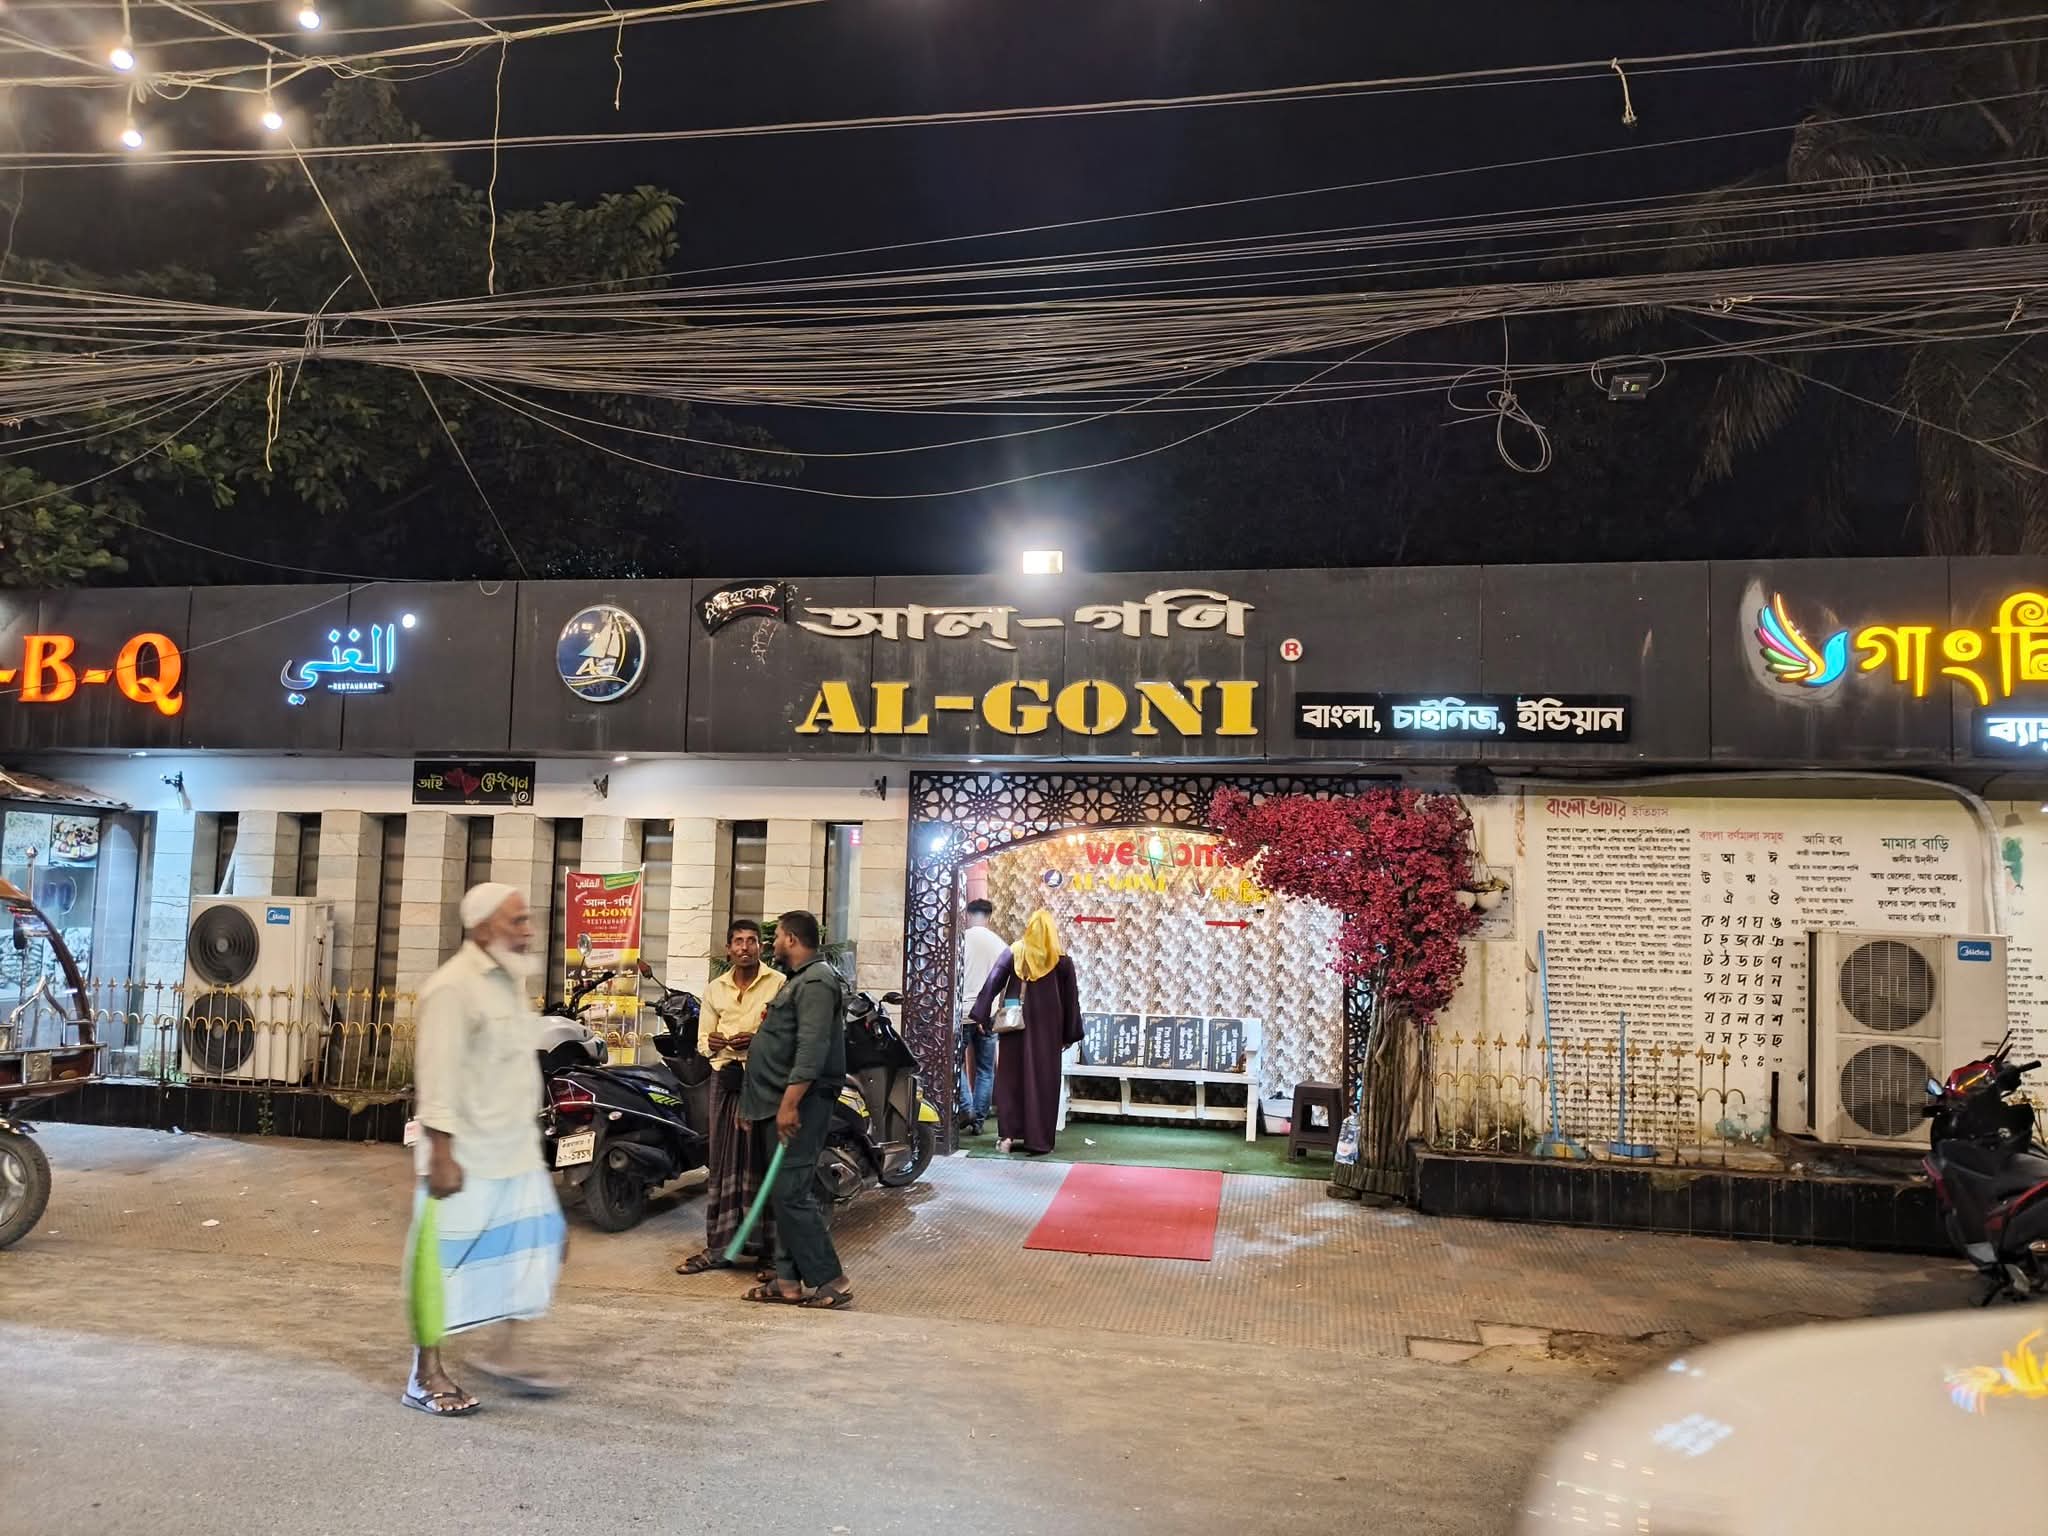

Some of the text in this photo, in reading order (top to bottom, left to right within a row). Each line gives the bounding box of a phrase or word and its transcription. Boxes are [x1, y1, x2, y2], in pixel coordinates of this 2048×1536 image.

[795, 679, 1260, 736] AL-GONI
[1302, 697, 1625, 735] বাংলা, চাইনিজ, ইন্ডিয়ান
[1881, 835, 1950, 852] মামার বাড়ি
[1721, 853, 1735, 864] আ
[1768, 851, 1778, 864] ঈ
[1701, 870, 1711, 884] উ
[1701, 915, 1715, 927] ক
[1737, 915, 1747, 928] গ
[1752, 916, 1763, 928] ঘ
[1703, 933, 1713, 945] চ
[1734, 934, 1749, 948] জ
[1752, 934, 1765, 947] ঝ
[1960, 946, 1990, 956] Midea
[1703, 949, 1714, 966] ট
[1720, 950, 1731, 966] ঠ
[1771, 956, 1782, 968] ণ
[1704, 973, 1715, 984] ত
[1737, 974, 1747, 986] দ
[1754, 974, 1764, 987] ধ
[1772, 975, 1782, 987] ন
[1704, 992, 1783, 1006] প ফ ব ভ ম
[1737, 1013, 1749, 1025] ল
[1772, 1014, 1783, 1026] শ
